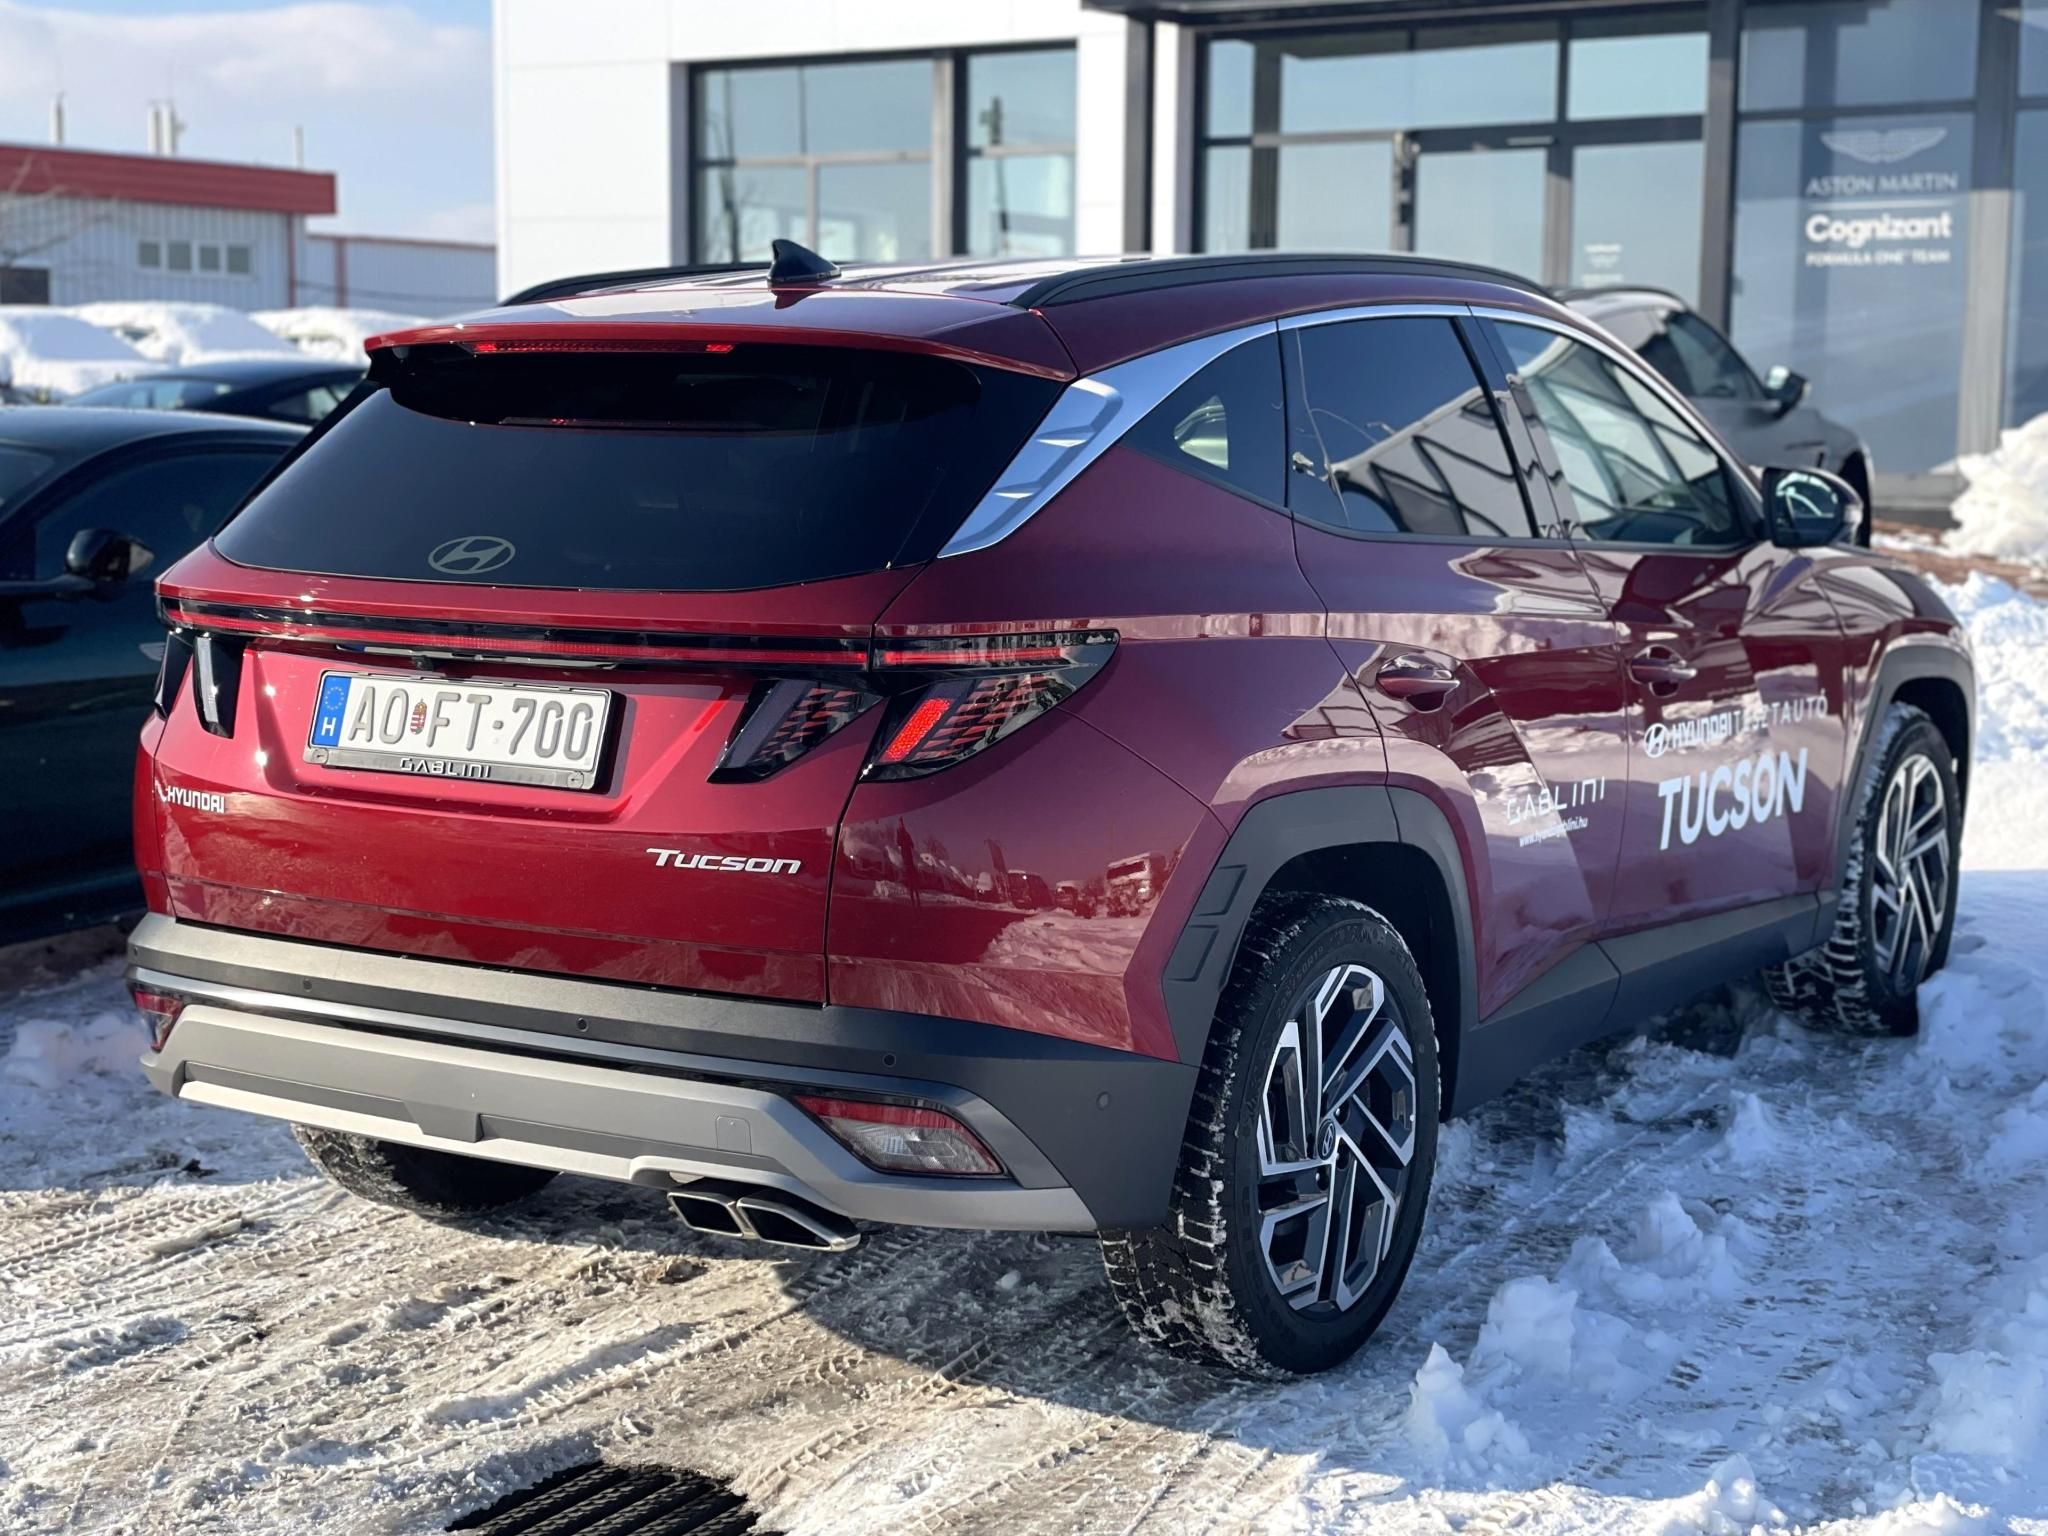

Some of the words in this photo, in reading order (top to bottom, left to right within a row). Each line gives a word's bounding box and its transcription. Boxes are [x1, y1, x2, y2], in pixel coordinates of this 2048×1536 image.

[1805, 175, 1873, 196] ASTON
[1878, 172, 1958, 192] MARTIN
[1805, 211, 1953, 248] Cognizant
[321, 716, 337, 737] H
[1671, 711, 1733, 749] HYUNDAI
[400, 757, 491, 779] GABLINI
[166, 785, 225, 814] HYUNDAI
[1505, 776, 1606, 826] GABLINI
[1657, 747, 1809, 851] TUCSON
